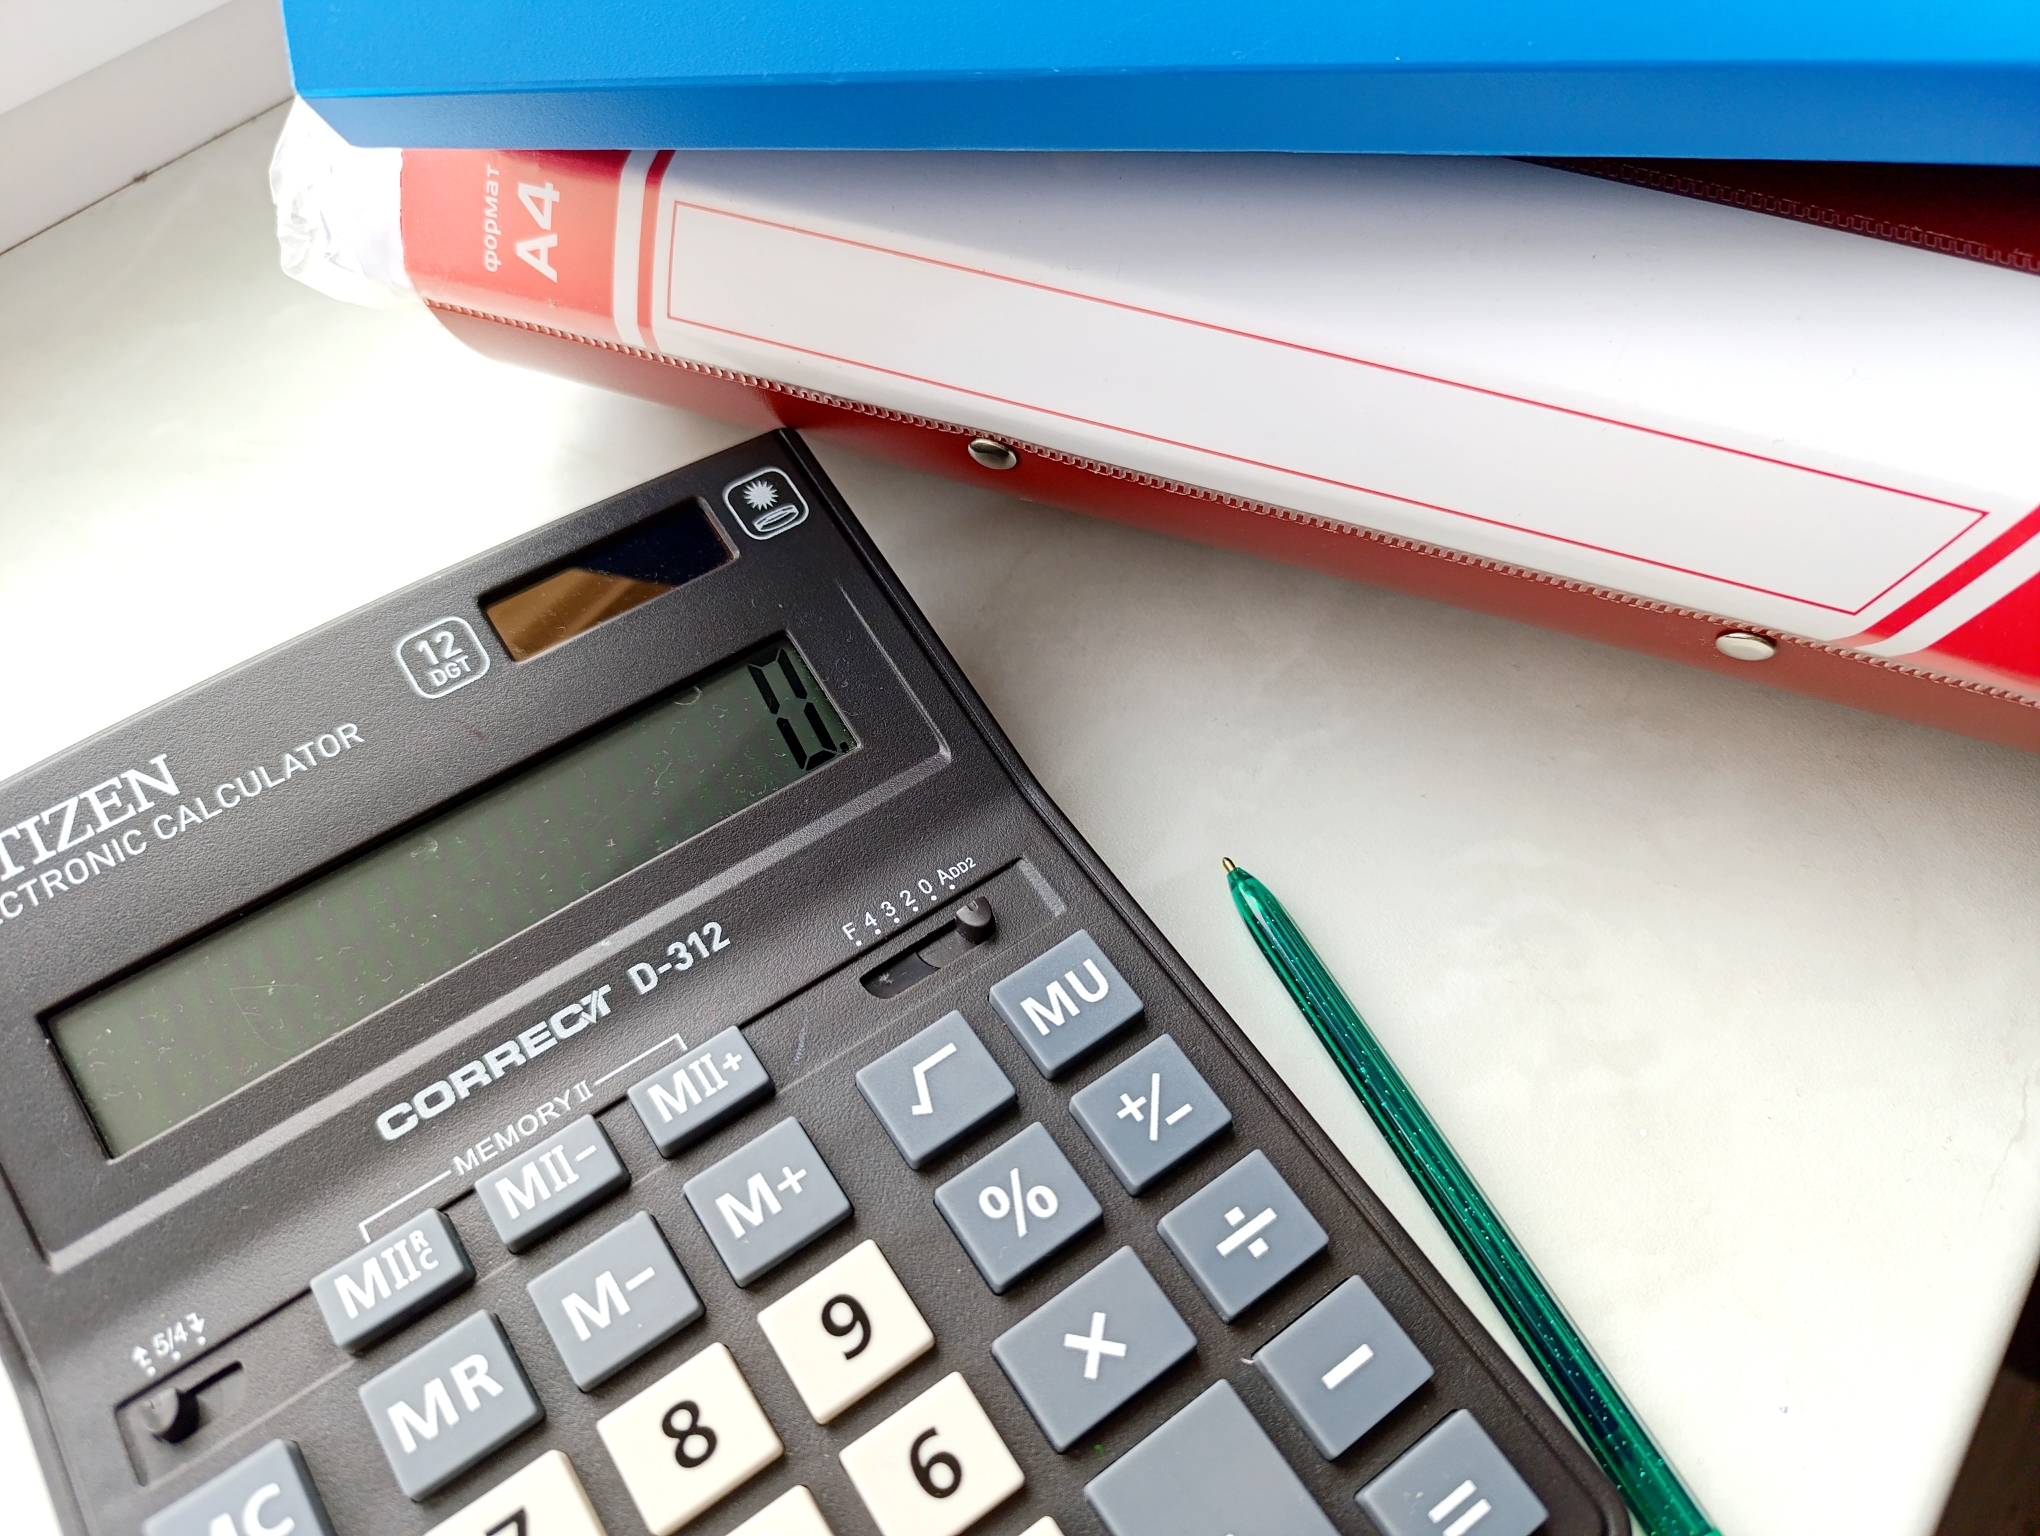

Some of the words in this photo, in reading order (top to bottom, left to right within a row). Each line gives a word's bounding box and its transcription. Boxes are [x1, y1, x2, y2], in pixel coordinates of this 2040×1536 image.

[482, 163, 502, 273] формат
[515, 181, 561, 284] A4
[418, 631, 463, 665] 12
[429, 655, 471, 687] DGT
[0, 829, 148, 925] CTRONIC
[152, 722, 366, 841] CALCULATOR
[841, 921, 857, 941] F
[864, 911, 878, 929] 4
[880, 900, 896, 918] 3
[899, 889, 916, 907] 2
[917, 878, 933, 895] 0
[626, 920, 732, 996] D-312
[1018, 957, 1111, 1037] MU
[452, 1089, 572, 1176] MEMORY
[713, 1165, 808, 1241] M+
[977, 1166, 1060, 1239] %
[820, 1293, 873, 1361] 9
[386, 1353, 504, 1454] MR
[660, 1399, 718, 1469] 8
[909, 1426, 964, 1500] 6
[208, 1482, 296, 1536] C
